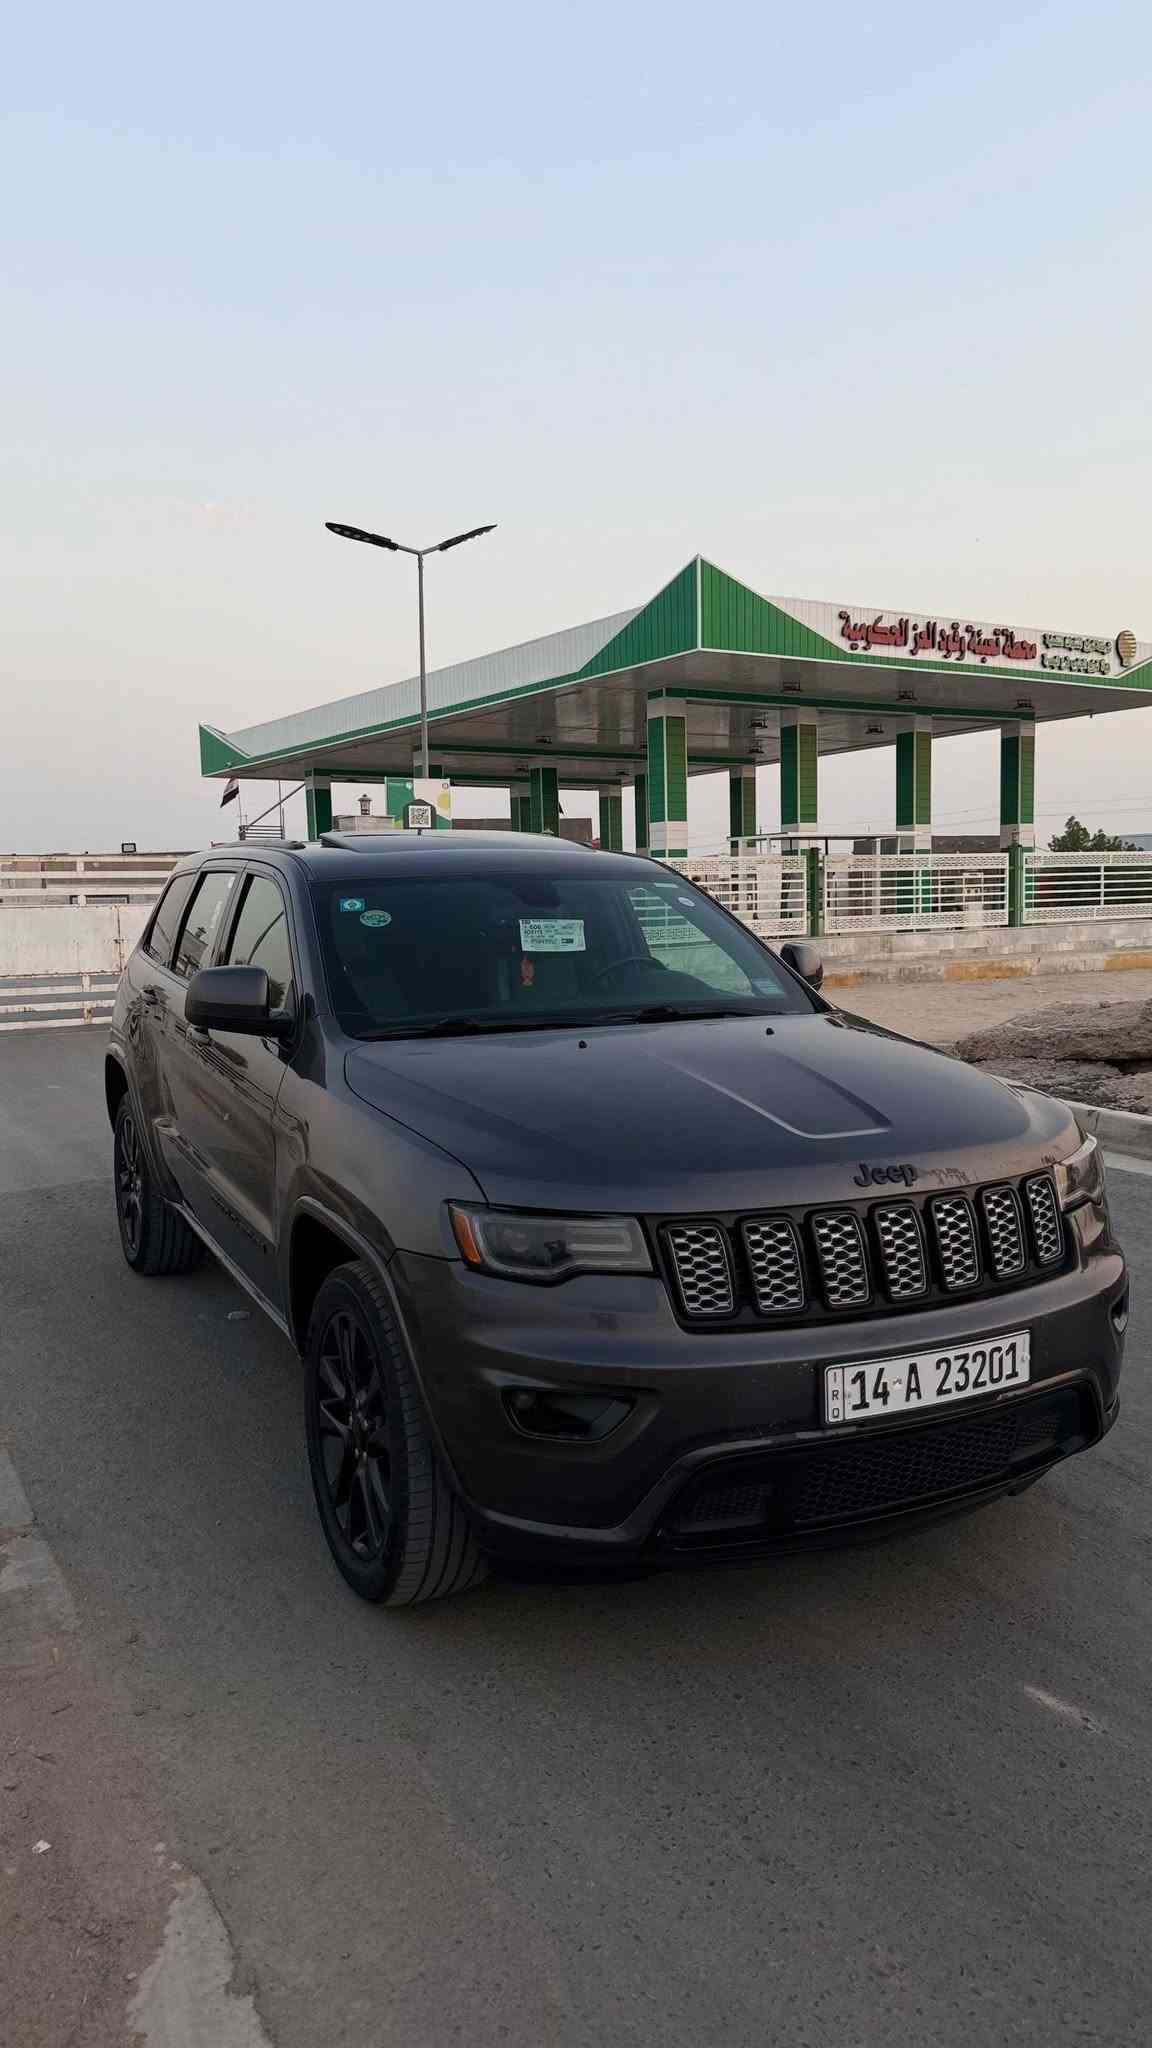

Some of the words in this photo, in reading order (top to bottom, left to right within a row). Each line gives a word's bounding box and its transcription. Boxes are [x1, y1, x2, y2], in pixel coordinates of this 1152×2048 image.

[838, 610, 909, 651] الحكومية
[938, 622, 966, 660] وقود
[965, 625, 1001, 664] تعبئة
[1000, 628, 1037, 660] محطة
[853, 1162, 915, 1187] Jeep
[850, 1367, 890, 1411] 14
[905, 1362, 922, 1402] A
[935, 1342, 1019, 1397] 23201
